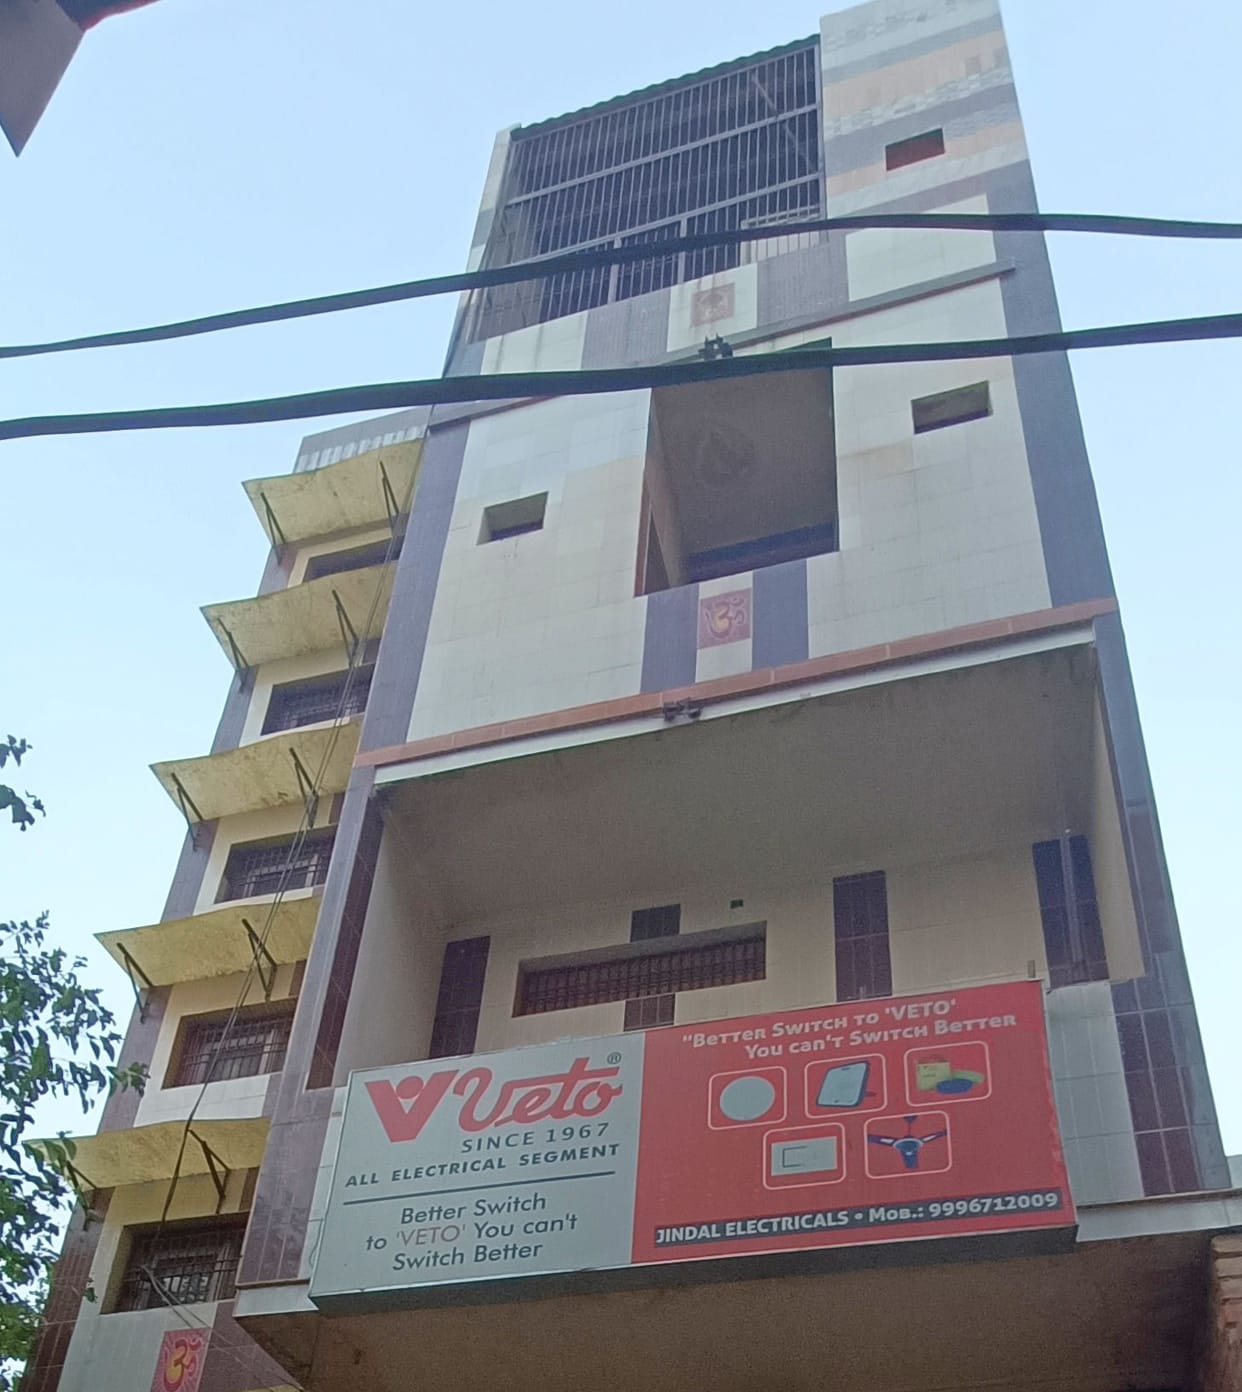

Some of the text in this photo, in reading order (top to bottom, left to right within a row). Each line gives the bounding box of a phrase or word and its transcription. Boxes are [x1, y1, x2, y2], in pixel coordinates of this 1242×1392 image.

[745, 1044, 783, 1060] You
[452, 1056, 624, 1132] Veto
[461, 1122, 609, 1153] SINCE 1967
[345, 1143, 621, 1188] ALL ELECTRICAL SEGMENT
[401, 1192, 547, 1225] Better Switch
[656, 1223, 721, 1243] JINDAL
[725, 1210, 849, 1237] ELECTRICALS
[929, 1192, 1058, 1218] 9996712009
[366, 1213, 578, 1251] to 'VETO' You can't
[392, 1243, 544, 1271] Switch Better
